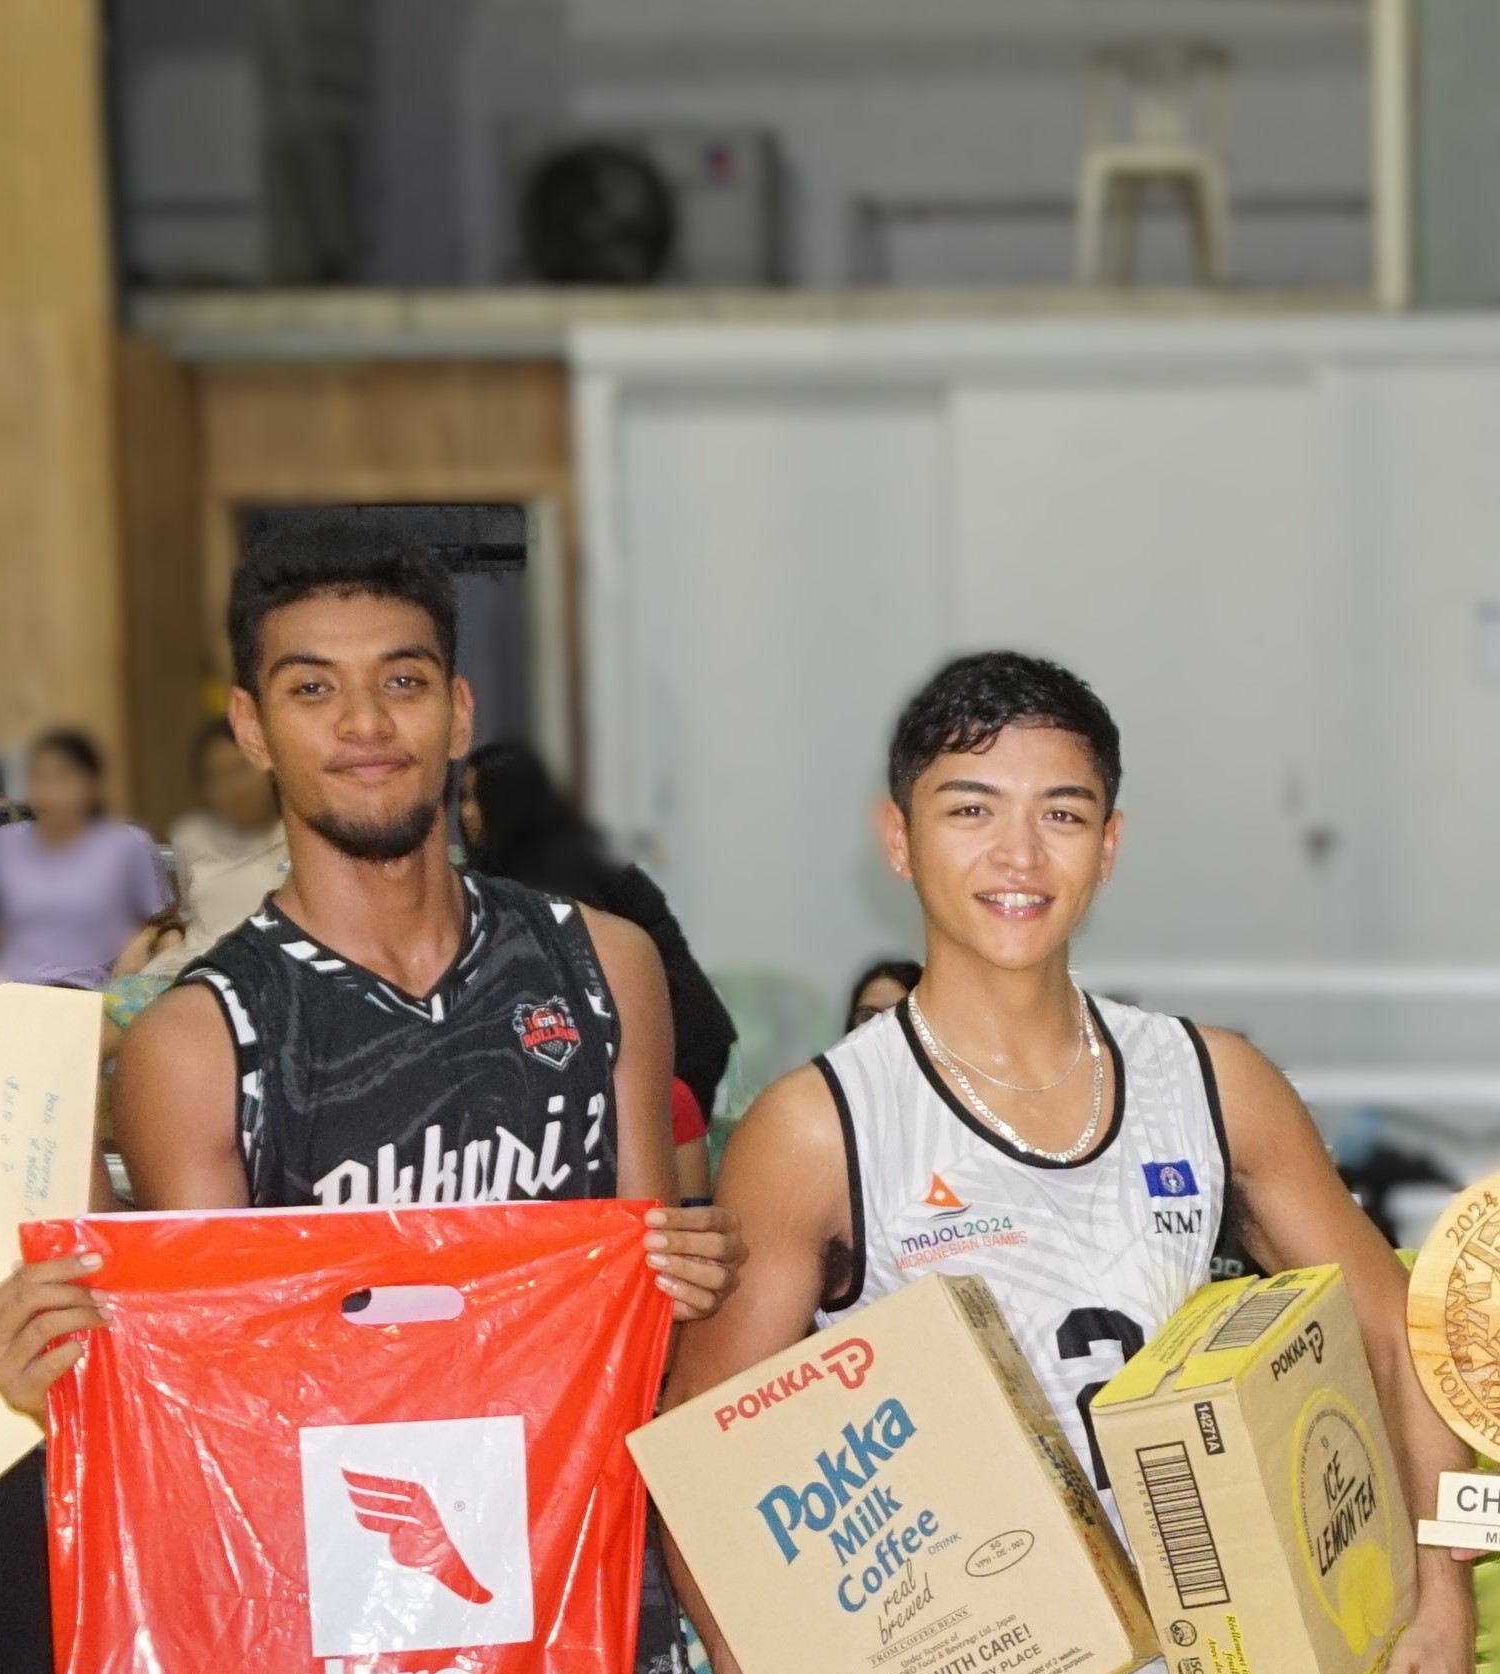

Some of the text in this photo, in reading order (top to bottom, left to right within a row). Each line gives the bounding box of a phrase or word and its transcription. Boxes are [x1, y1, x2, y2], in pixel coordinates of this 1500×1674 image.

[1445, 1191, 1499, 1246] 2024
[894, 1231, 1028, 1270] MICRONESIAN GAMES
[1271, 1334, 1308, 1381] POKKA
[714, 1361, 825, 1432] POKKA
[1197, 1403, 1221, 1452] 14271A
[755, 1398, 918, 1566] Pokka
[1323, 1450, 1344, 1510] ICE
[828, 1484, 903, 1567] Milk
[1317, 1498, 1356, 1576] LEMON
[1354, 1474, 1376, 1528] TEA
[837, 1508, 962, 1613] Coffee DRINK
[884, 1558, 916, 1615] real
[869, 1607, 969, 1665] FROM COFFEE BEANS
[878, 1572, 934, 1645] brewed
[898, 1650, 923, 1669] Under
[976, 1622, 1034, 1664] CARE!
[998, 1642, 1043, 1673] PLACE
